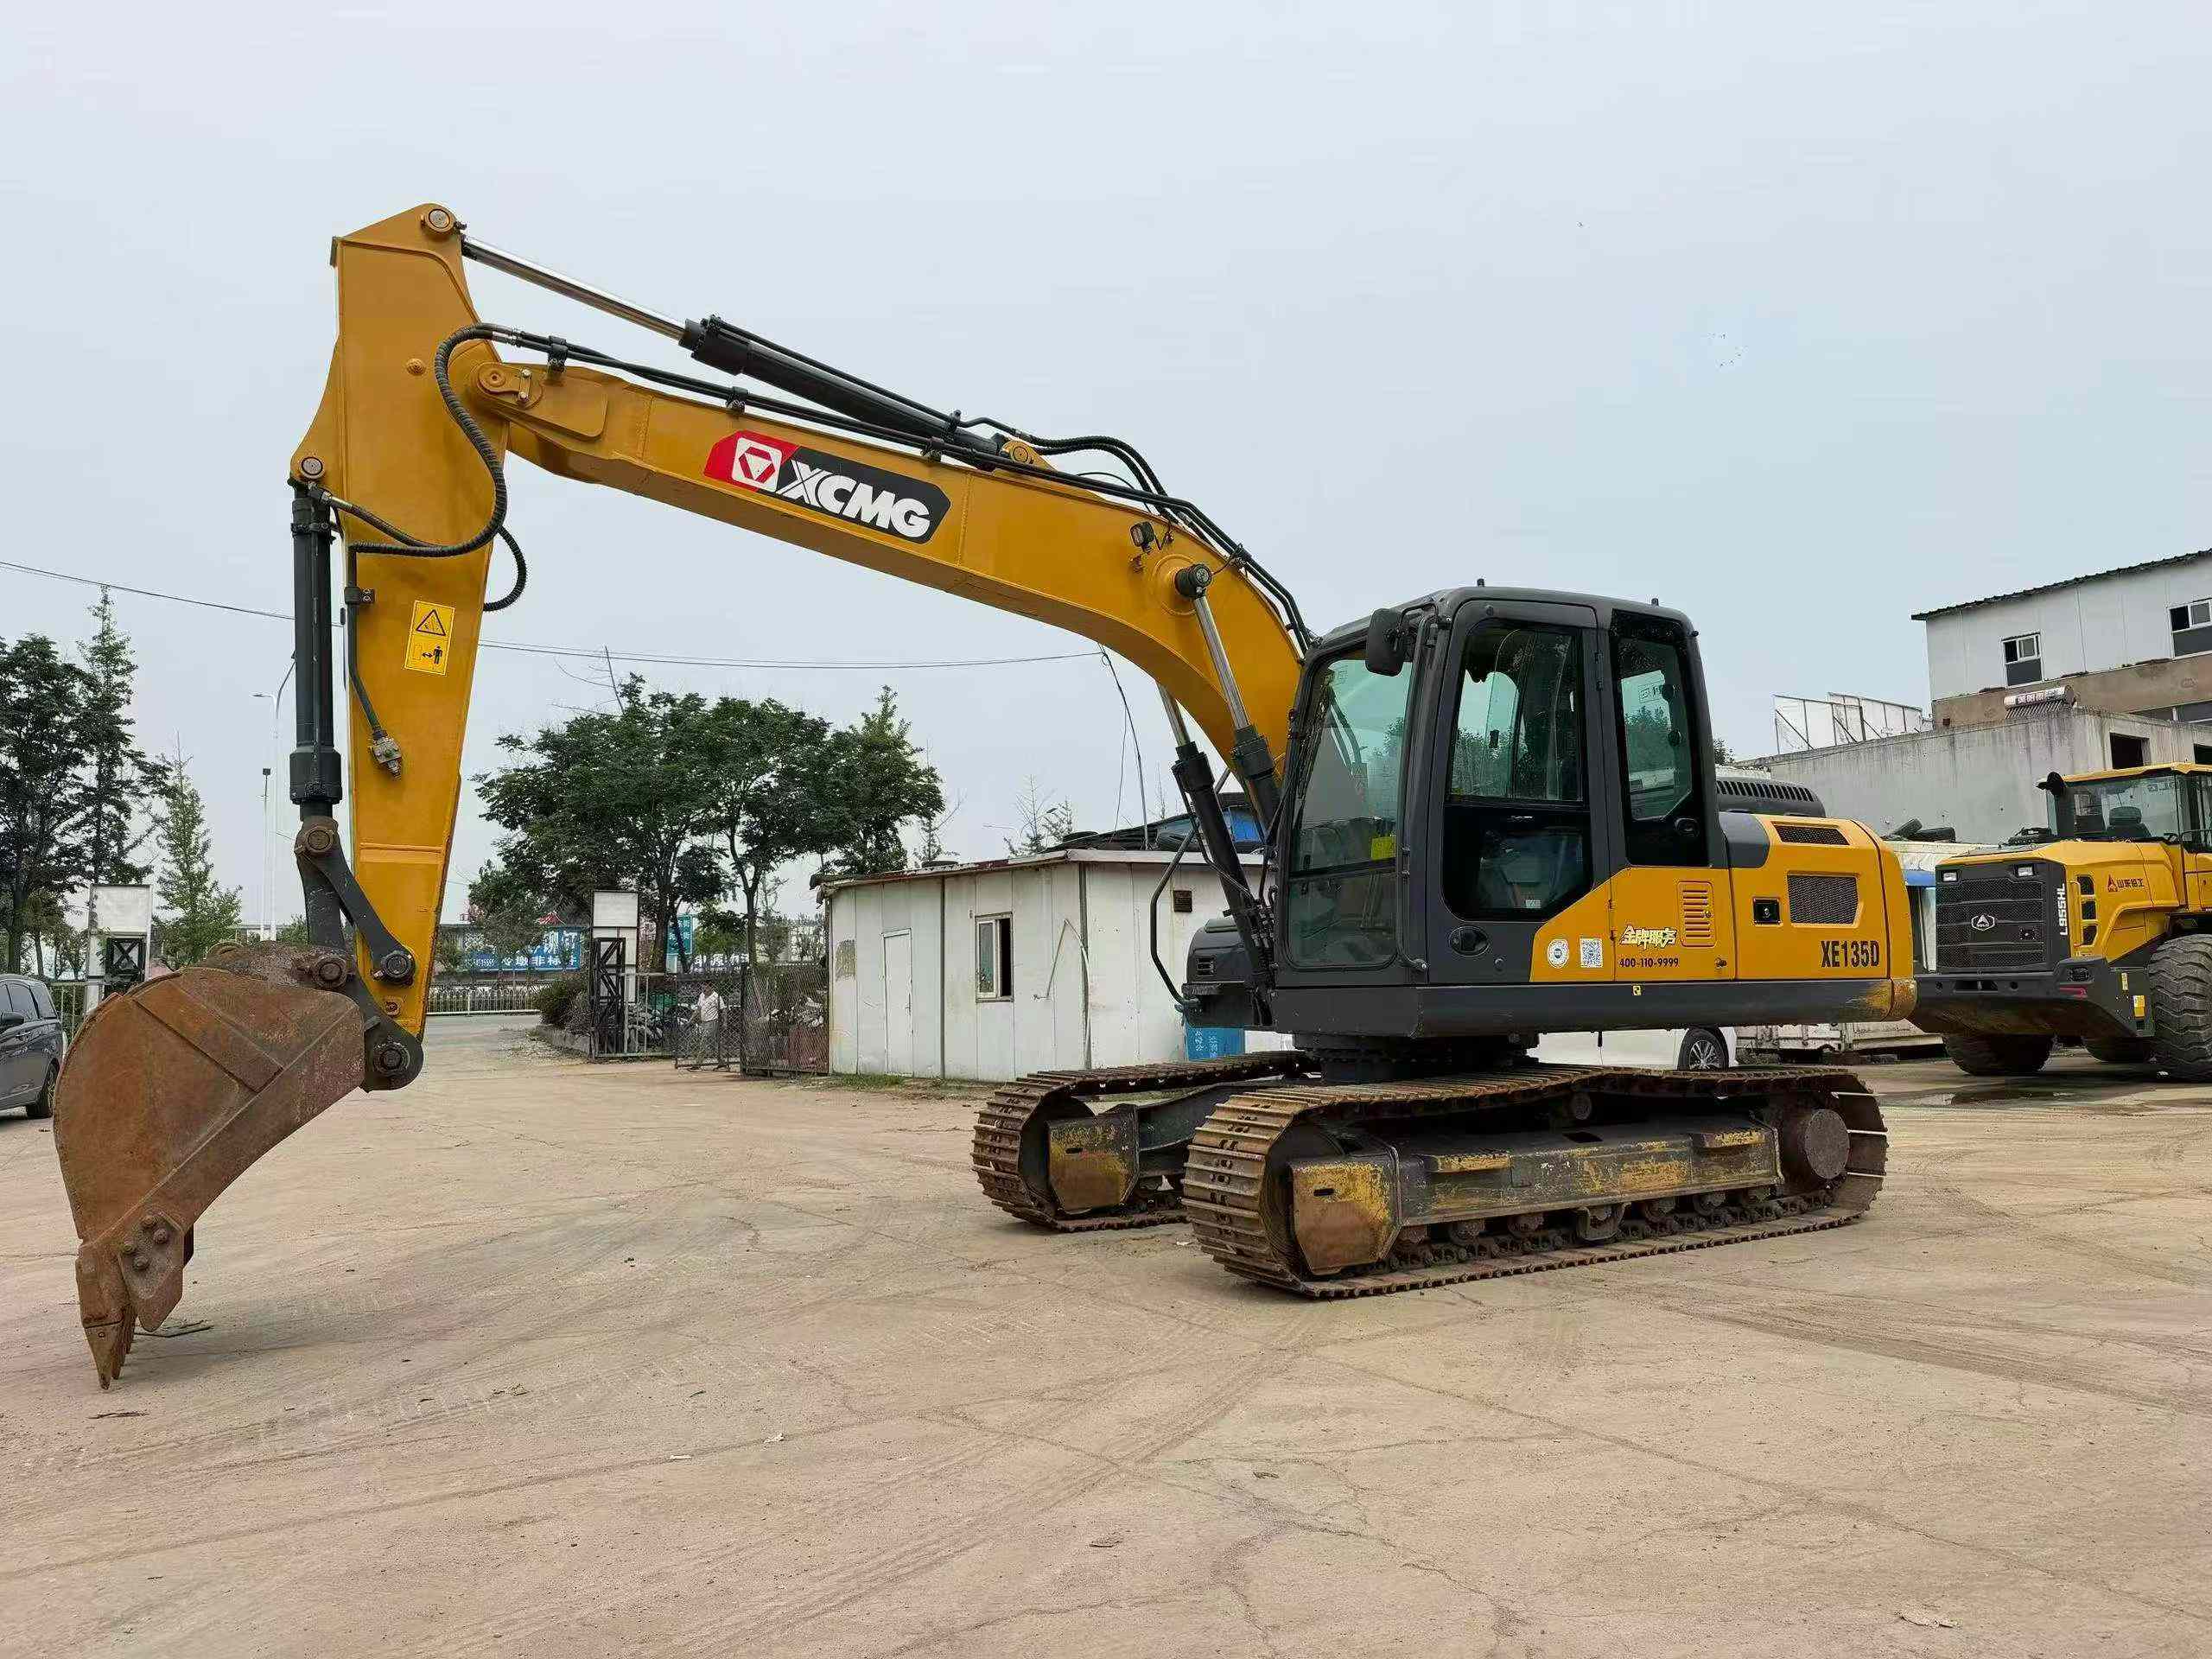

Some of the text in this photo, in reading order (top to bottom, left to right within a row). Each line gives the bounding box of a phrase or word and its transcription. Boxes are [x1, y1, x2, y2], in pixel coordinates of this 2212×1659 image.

[776, 459, 931, 537] XCMG
[1619, 957, 1679, 968] 400-110-9999
[1821, 940, 1880, 968] XE135D
